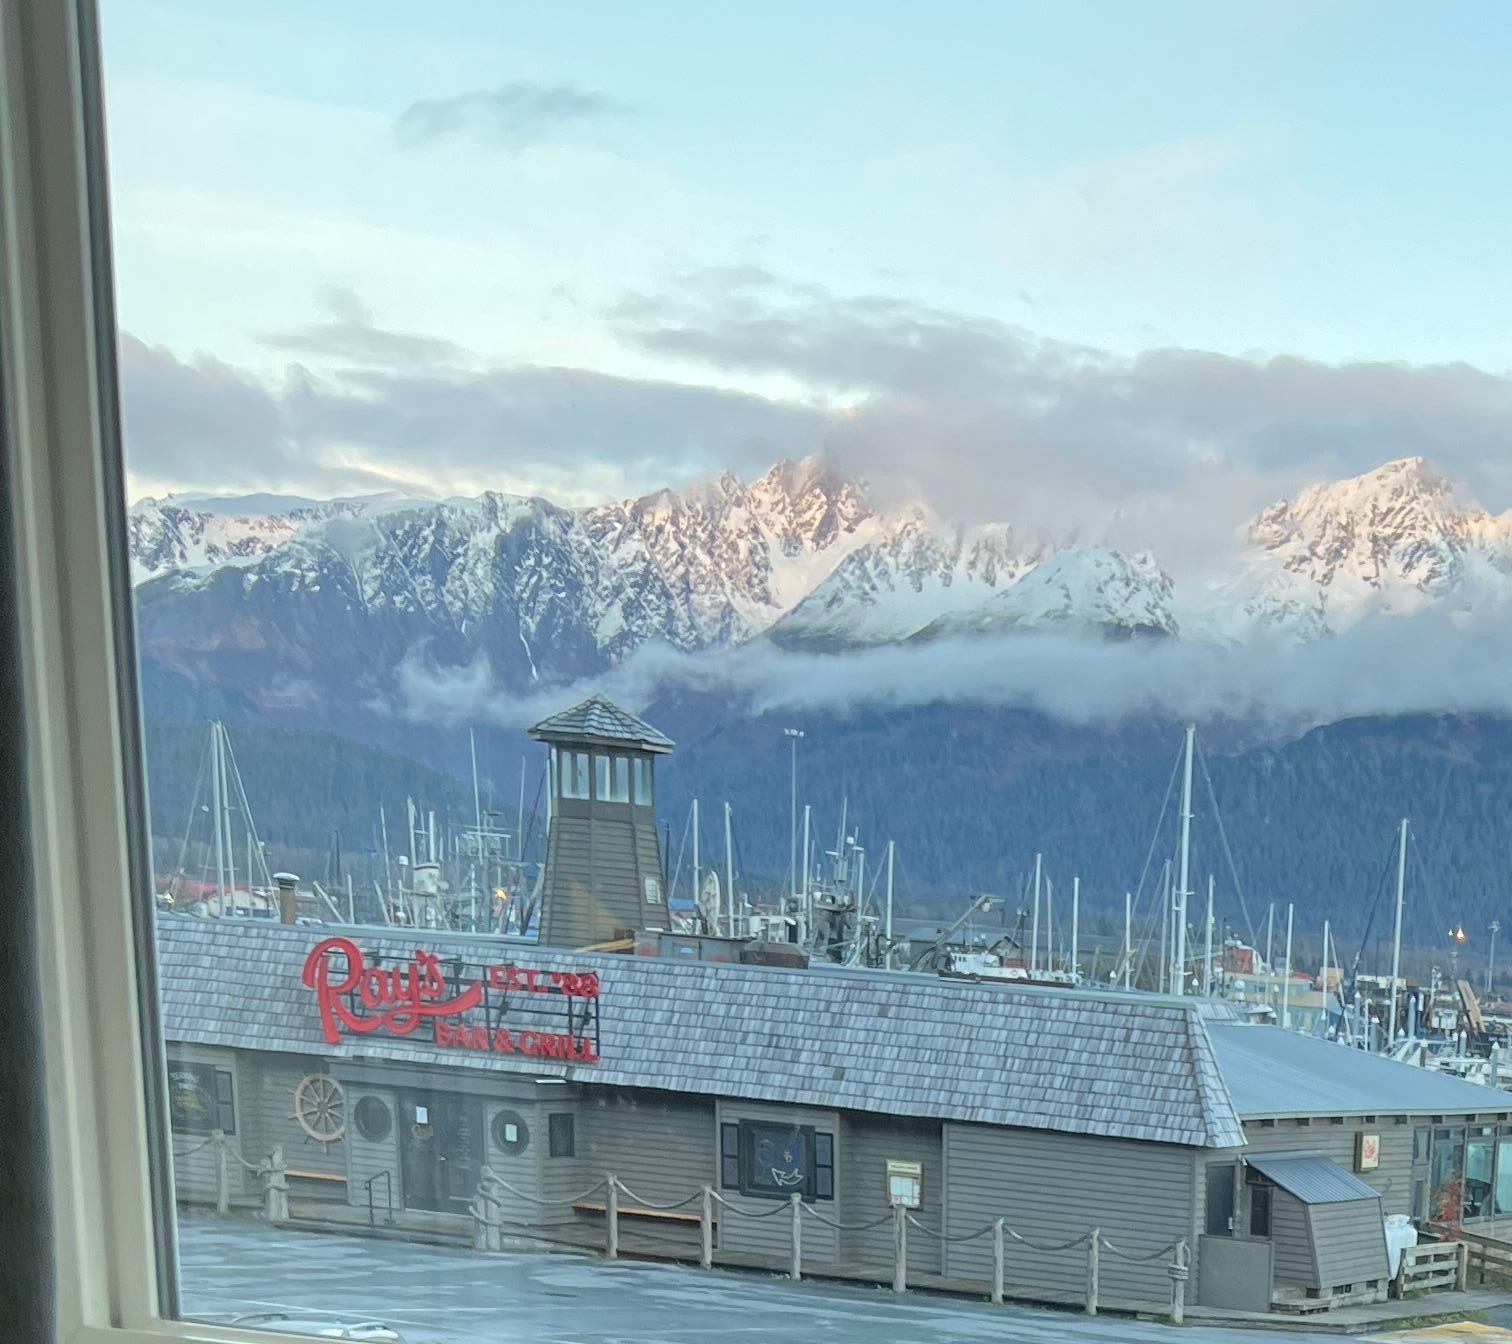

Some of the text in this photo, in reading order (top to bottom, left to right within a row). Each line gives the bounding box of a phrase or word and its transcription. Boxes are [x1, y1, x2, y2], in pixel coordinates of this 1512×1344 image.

[302, 937, 482, 1045] Ray's
[490, 965, 548, 993] EST.
[435, 1022, 599, 1064] BAR & GRILL
